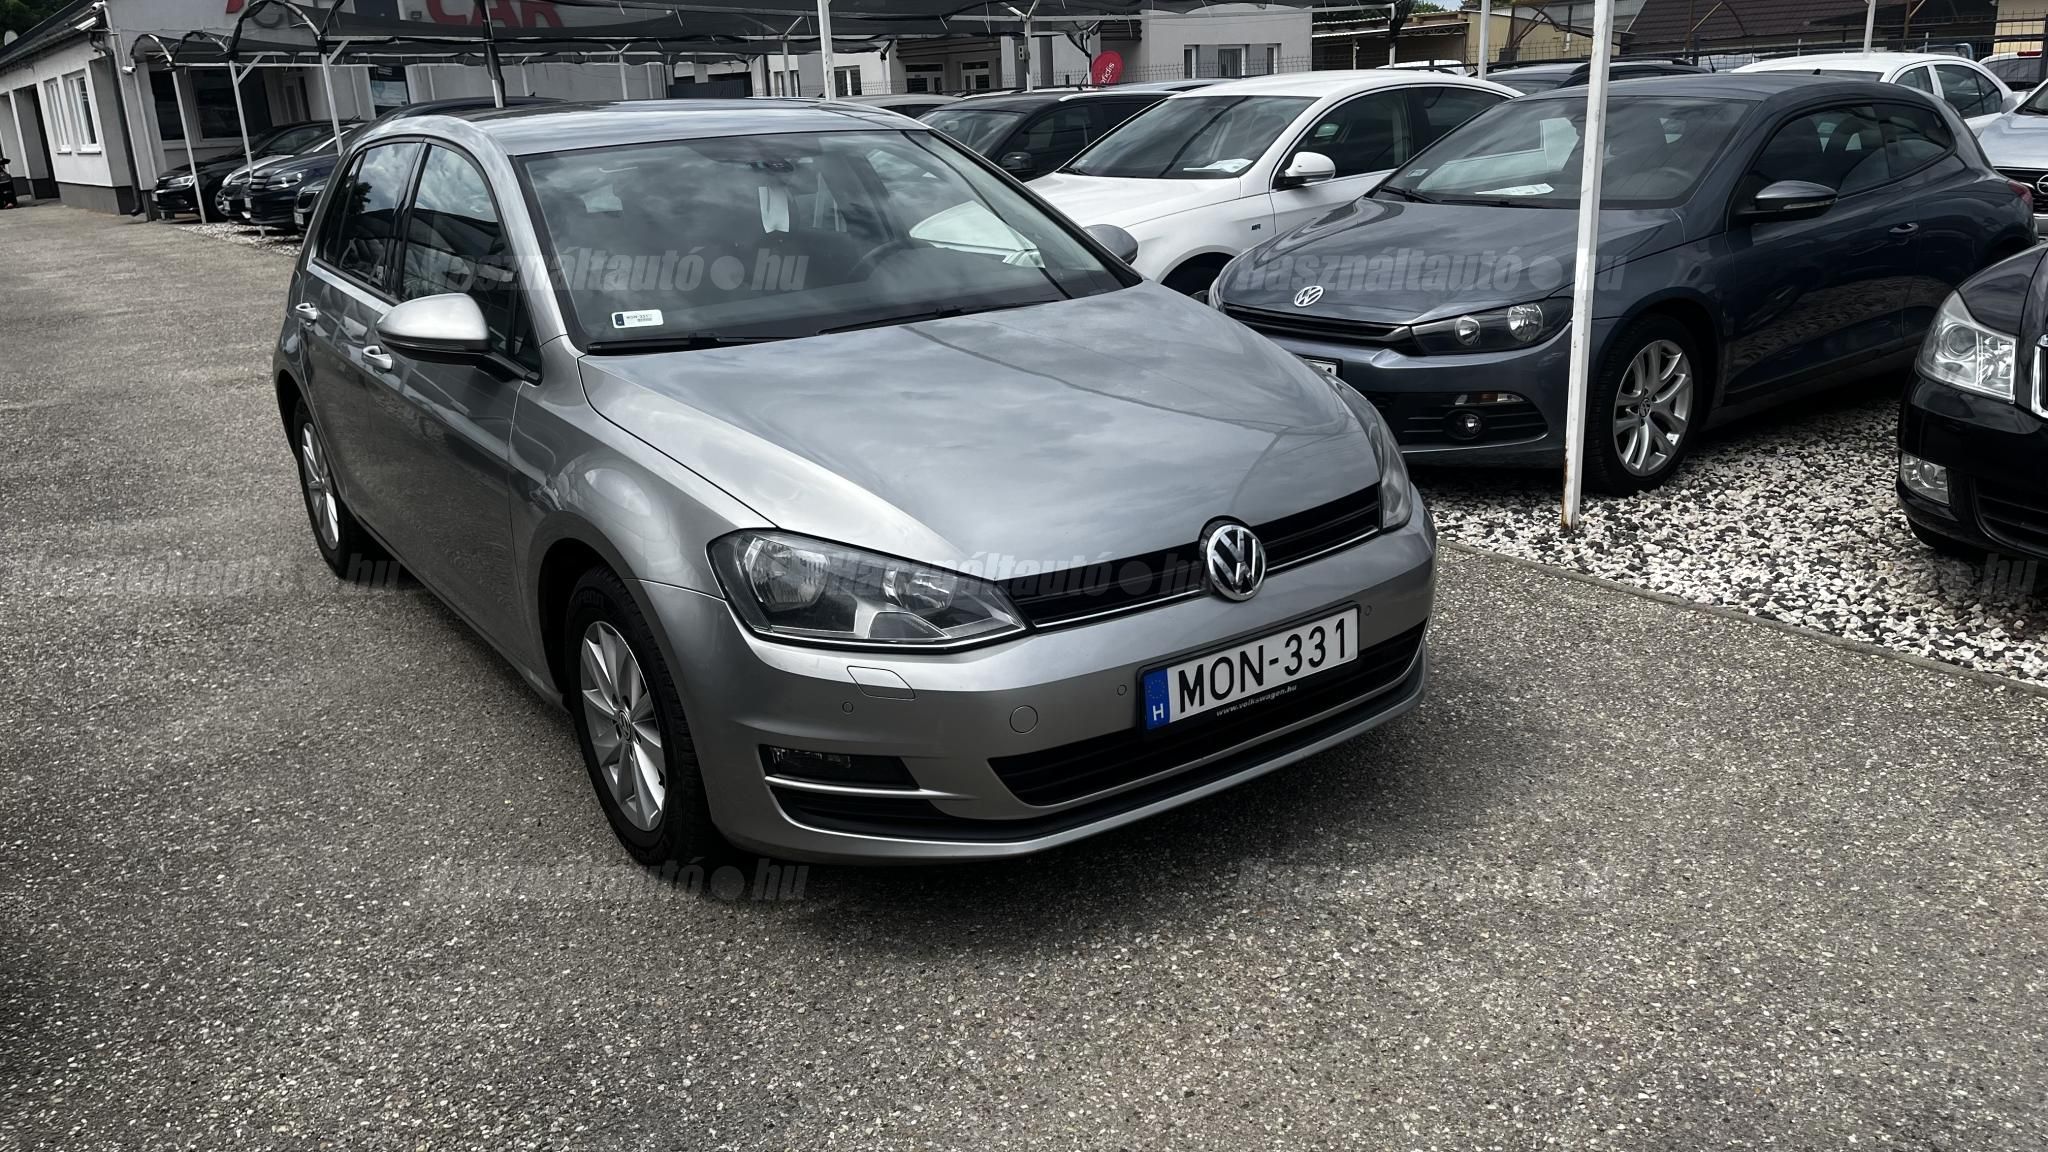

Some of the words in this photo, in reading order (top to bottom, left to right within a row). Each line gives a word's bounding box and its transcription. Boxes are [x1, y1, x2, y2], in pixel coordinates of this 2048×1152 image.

[1152, 703, 1165, 722] H
[1178, 618, 1345, 714] MON-331
[1216, 684, 1297, 717] www.volkswagen.hu
